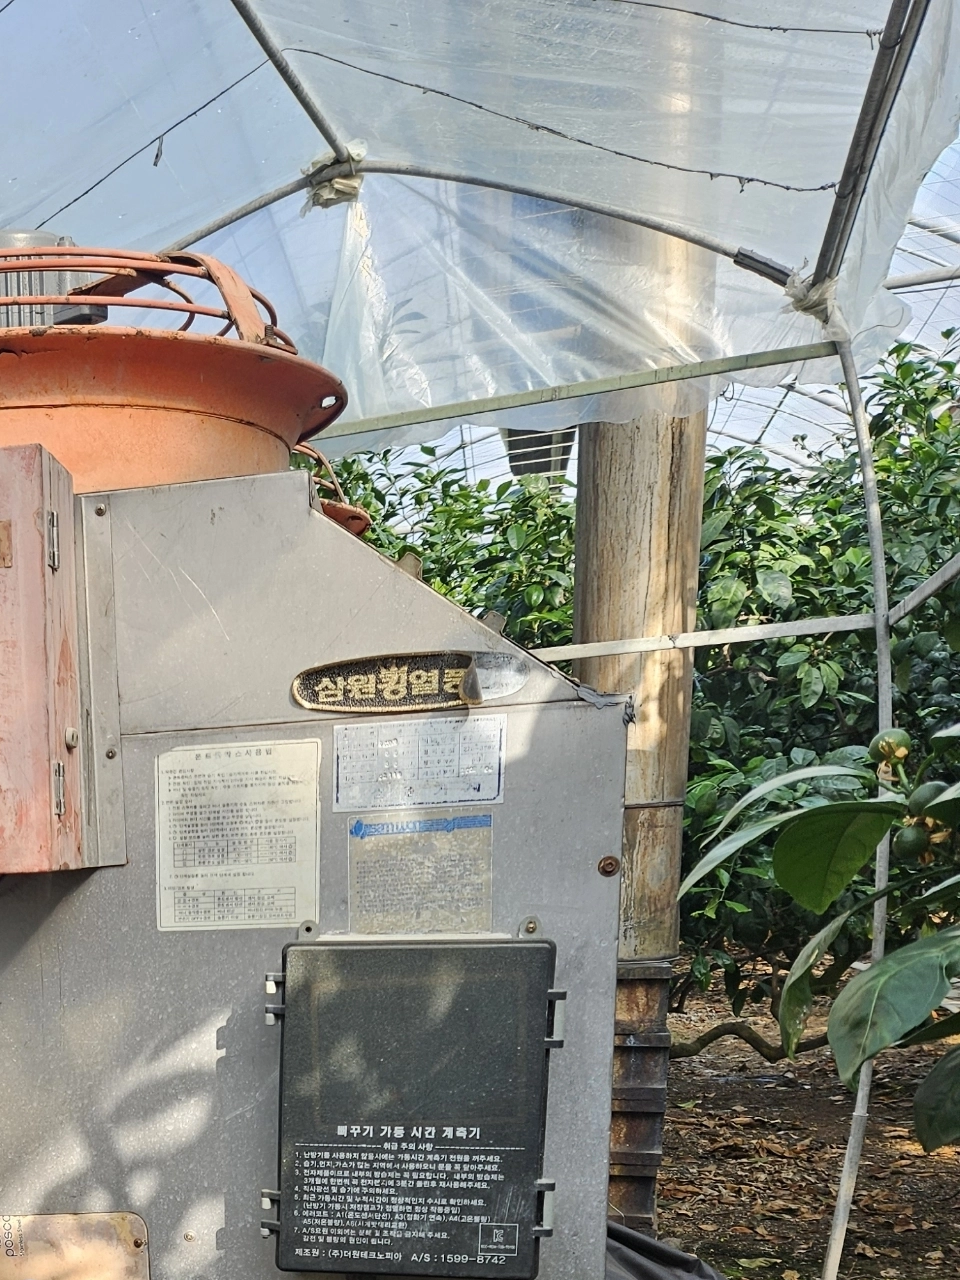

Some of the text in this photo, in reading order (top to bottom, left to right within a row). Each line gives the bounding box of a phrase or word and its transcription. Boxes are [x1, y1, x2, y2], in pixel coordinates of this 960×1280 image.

[380, 1126, 405, 1138] 가동
[411, 1126, 436, 1139] 시간
[442, 1127, 480, 1139] 계측기
[400, 1142, 416, 1151] 주의
[418, 1143, 433, 1151] 사항
[294, 1248, 319, 1257] 제조원
[411, 1253, 430, 1262] A/S
[440, 1254, 506, 1265] 1599-8742
